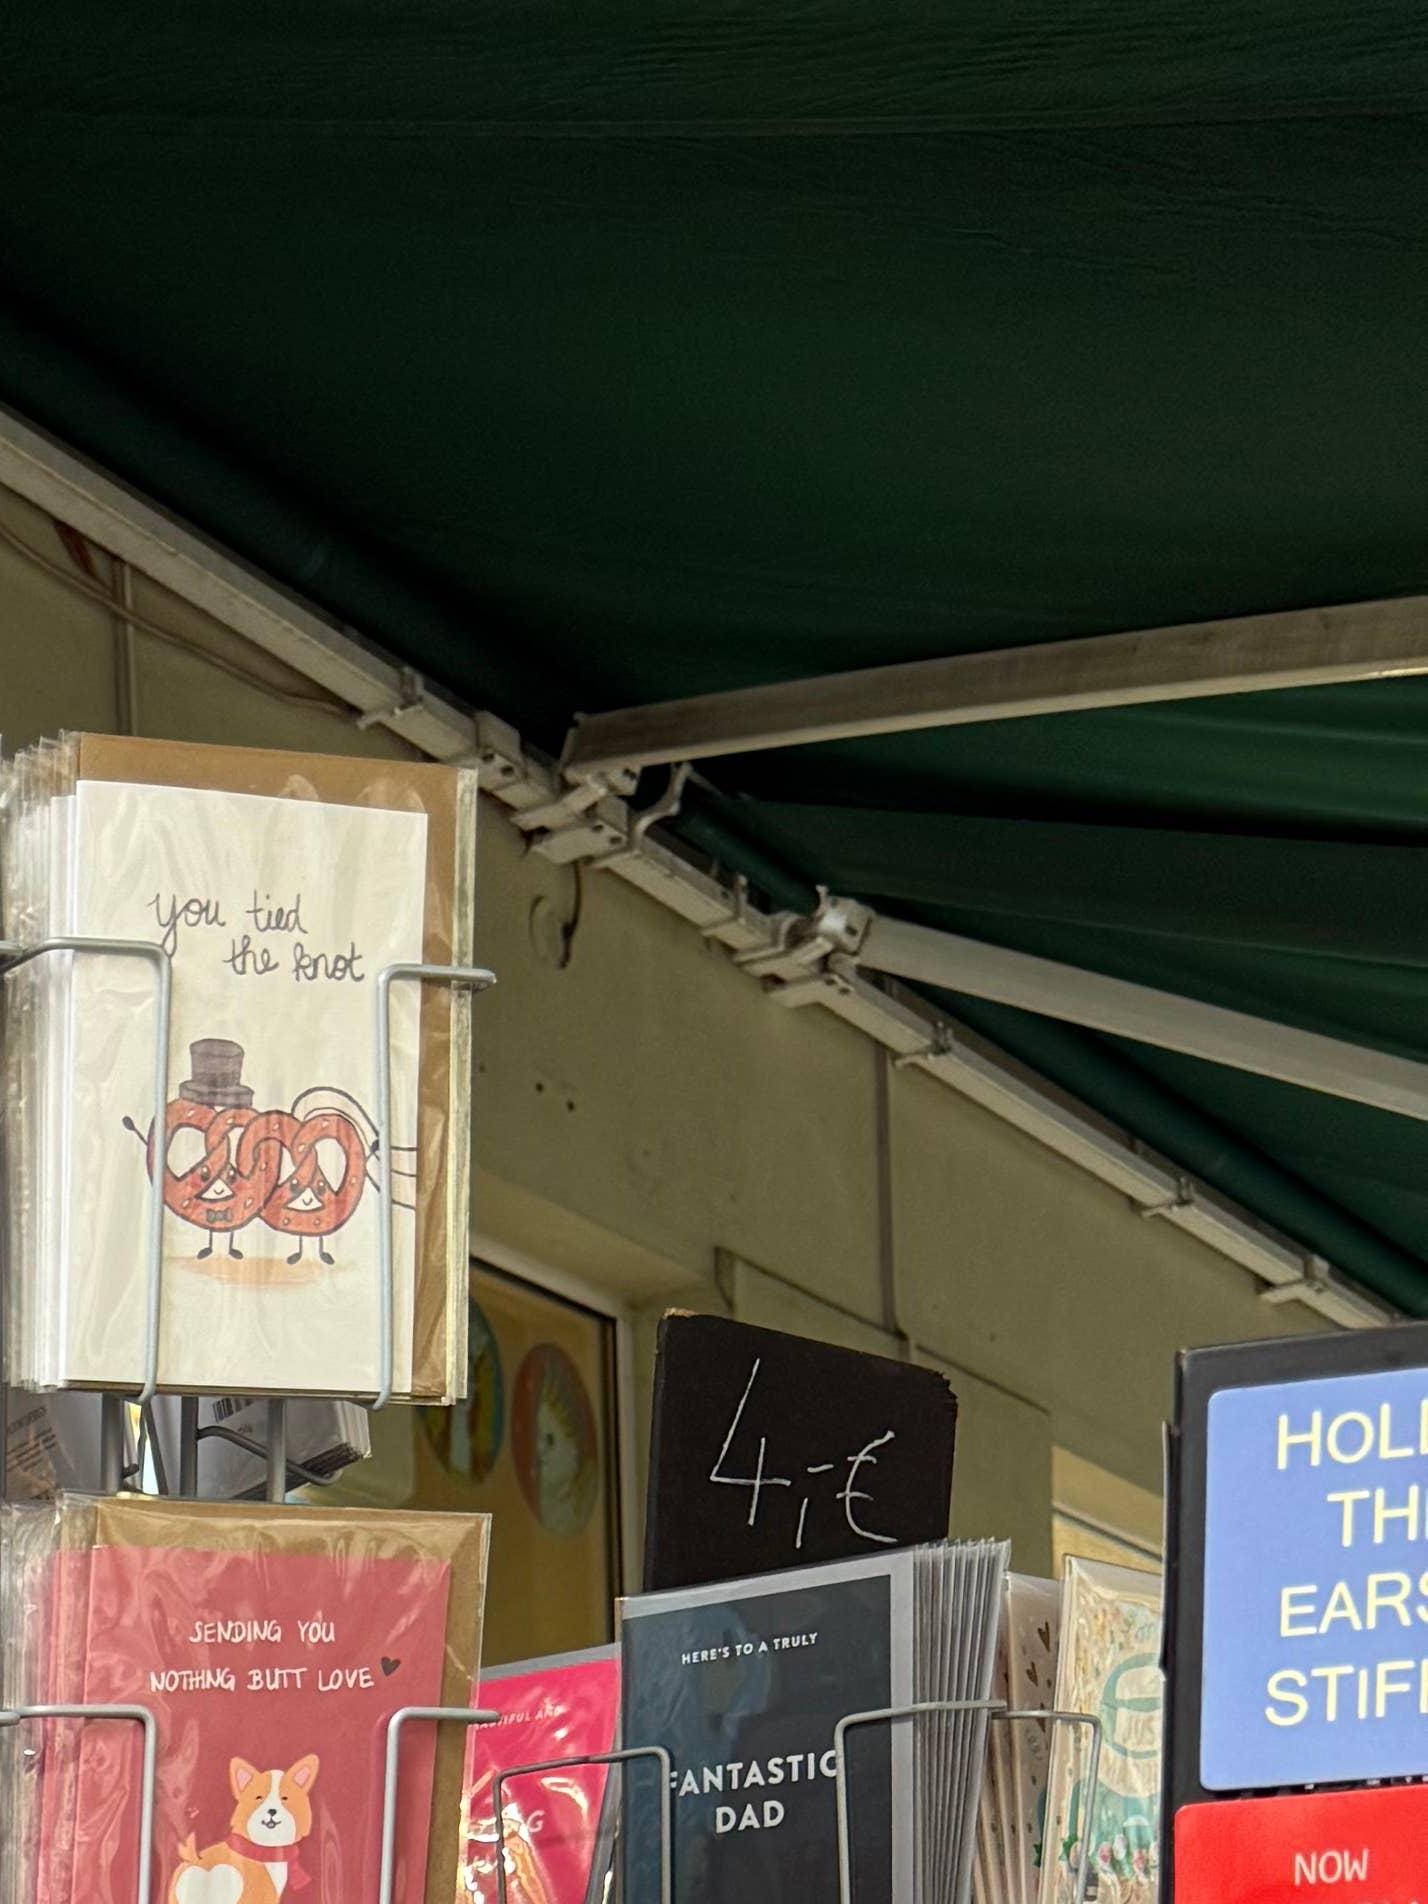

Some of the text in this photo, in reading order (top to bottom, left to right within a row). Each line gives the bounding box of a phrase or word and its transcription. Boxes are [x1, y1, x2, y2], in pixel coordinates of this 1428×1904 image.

[246, 887, 307, 934] tied
[223, 939, 365, 983] the knot
[189, 1620, 335, 1646] SENDING YOU
[682, 1632, 819, 1665] HERE'S TRULY
[150, 1664, 374, 1693] NOTHING BUTT LOVE
[715, 1801, 785, 1834] DAD
[1295, 1849, 1369, 1885] NOW
